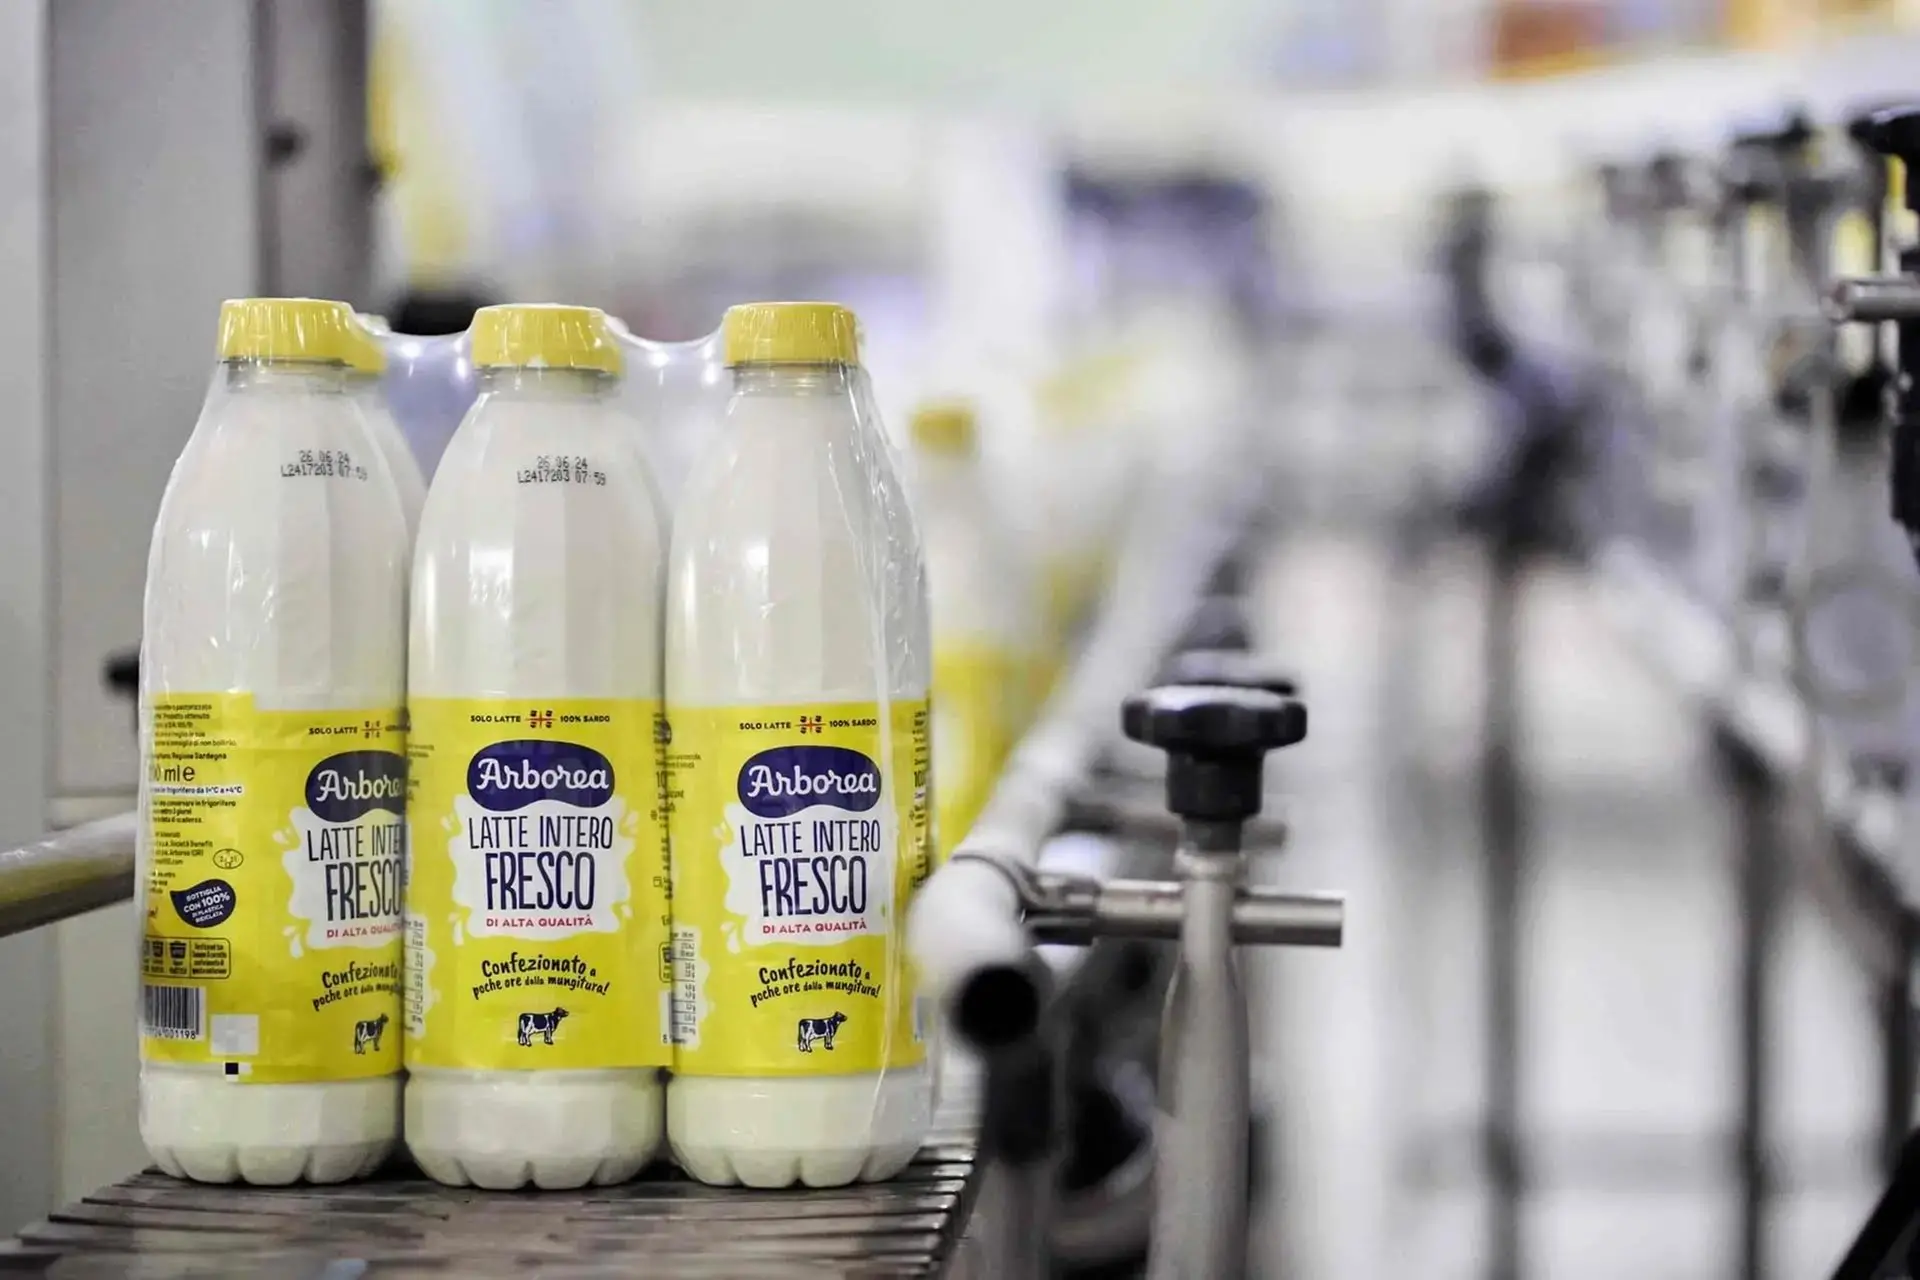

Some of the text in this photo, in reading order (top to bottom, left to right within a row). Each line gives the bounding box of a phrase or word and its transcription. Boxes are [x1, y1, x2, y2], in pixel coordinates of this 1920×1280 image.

[333, 726, 358, 734] LATTE
[470, 714, 611, 723] SOLO LATTE 100% SARDO
[739, 718, 877, 731] SOLO LATTE 100% SARDO
[316, 769, 402, 802] Arbore
[476, 757, 610, 790] Arborea
[747, 764, 877, 798] Arborea
[307, 825, 364, 862] LATTE
[468, 815, 614, 850] LATTE INTERO
[740, 821, 803, 857] LATTE
[812, 819, 881, 853] INTERO
[325, 858, 402, 922] FRESCO
[485, 850, 596, 911] FRESCO
[759, 854, 867, 918] FRESCO
[184, 891, 231, 913] CON 100%
[326, 929, 339, 939] DI
[341, 927, 368, 938] ALTA
[486, 913, 593, 927] DI ALTA QUALITÀ
[762, 917, 867, 934] DI ALTA QUALITÀ
[481, 951, 597, 978] Confezionato a
[758, 957, 871, 985] Confezionato a
[312, 989, 342, 1012] poche
[344, 987, 358, 998] ore
[472, 978, 503, 1001] poche
[504, 976, 522, 988] ore
[547, 975, 611, 996] mungitura!
[750, 985, 781, 1008] poche
[783, 982, 801, 994] ore
[825, 979, 882, 998] mungitura!
